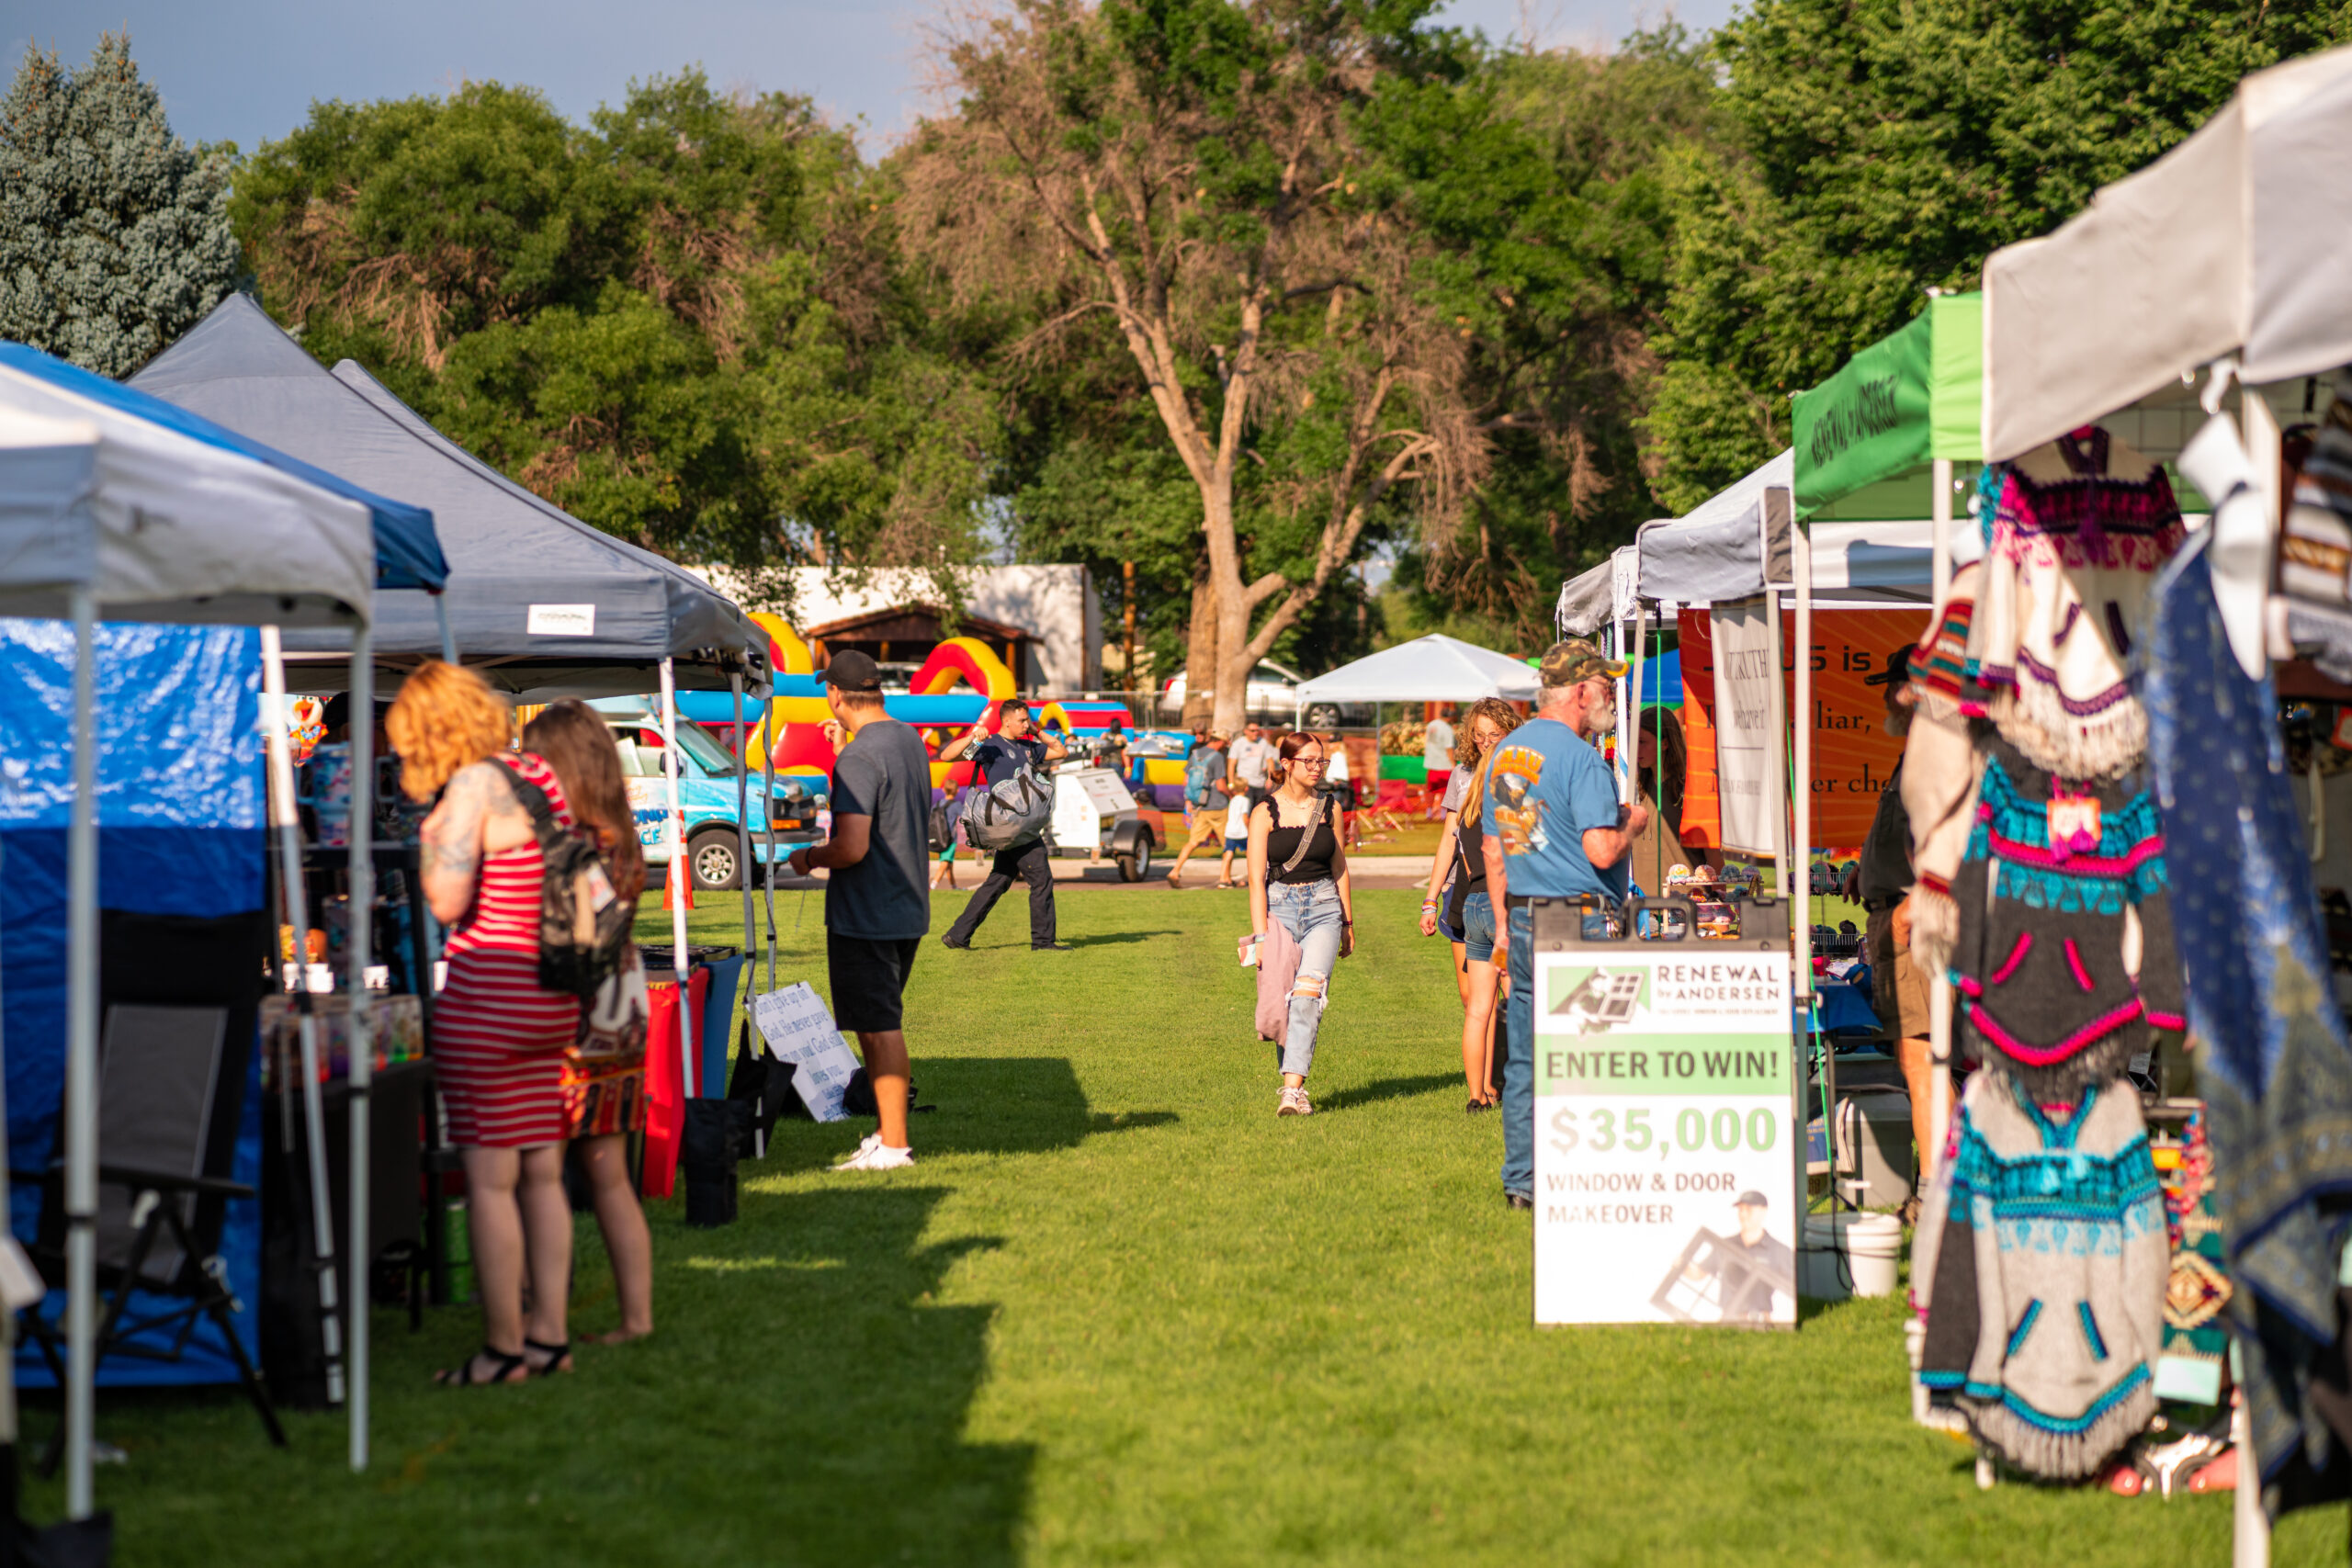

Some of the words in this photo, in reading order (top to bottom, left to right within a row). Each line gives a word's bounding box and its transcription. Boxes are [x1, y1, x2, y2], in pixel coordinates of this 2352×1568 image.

[1842, 645, 1871, 671] is
[1815, 700, 1871, 734] liar,
[1657, 964, 1780, 982] RENEWAL
[1675, 986, 1780, 1000] ANDERSEN
[810, 1010, 829, 1030] gave
[810, 1033, 831, 1054] God
[1546, 1051, 1649, 1078] ENTER
[1657, 1051, 1696, 1078] TO
[1702, 1051, 1779, 1078] WIN!
[1549, 1106, 1777, 1162] $35,000
[1546, 1173, 1644, 1192] WINDOW
[1650, 1173, 1667, 1192] &
[1675, 1173, 1736, 1192] DOOR
[1547, 1204, 1675, 1224] MAKEOVER
